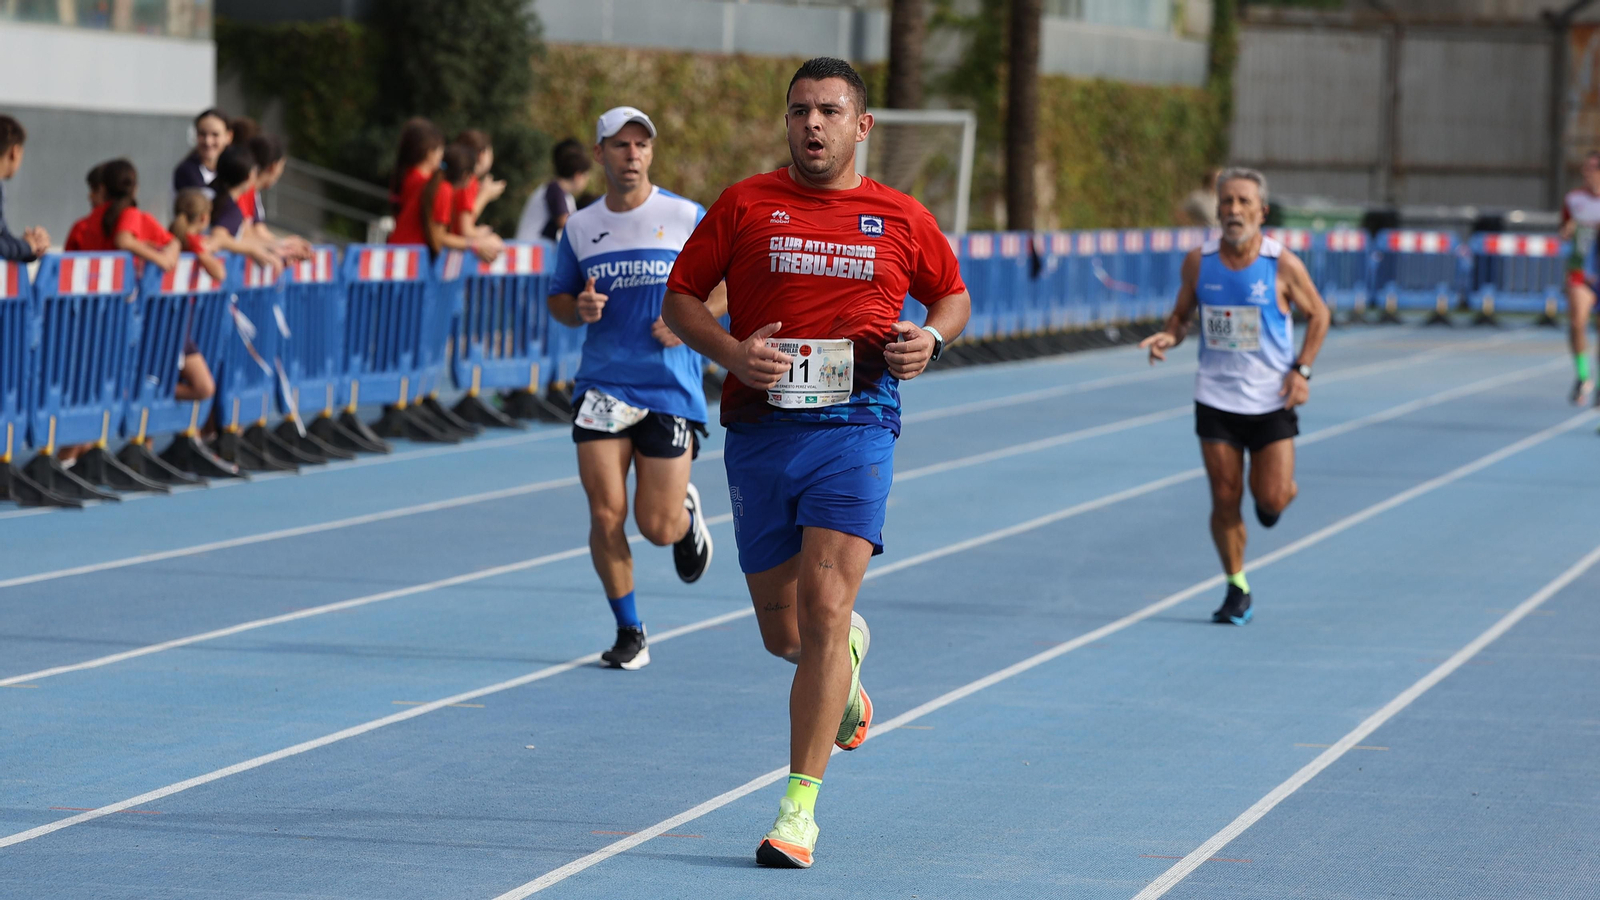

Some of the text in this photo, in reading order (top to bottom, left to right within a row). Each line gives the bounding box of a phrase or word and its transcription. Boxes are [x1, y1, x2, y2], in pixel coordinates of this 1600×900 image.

[769, 236, 876, 259] CLUB ATLETISMO
[769, 252, 874, 282] TREBUJENA
